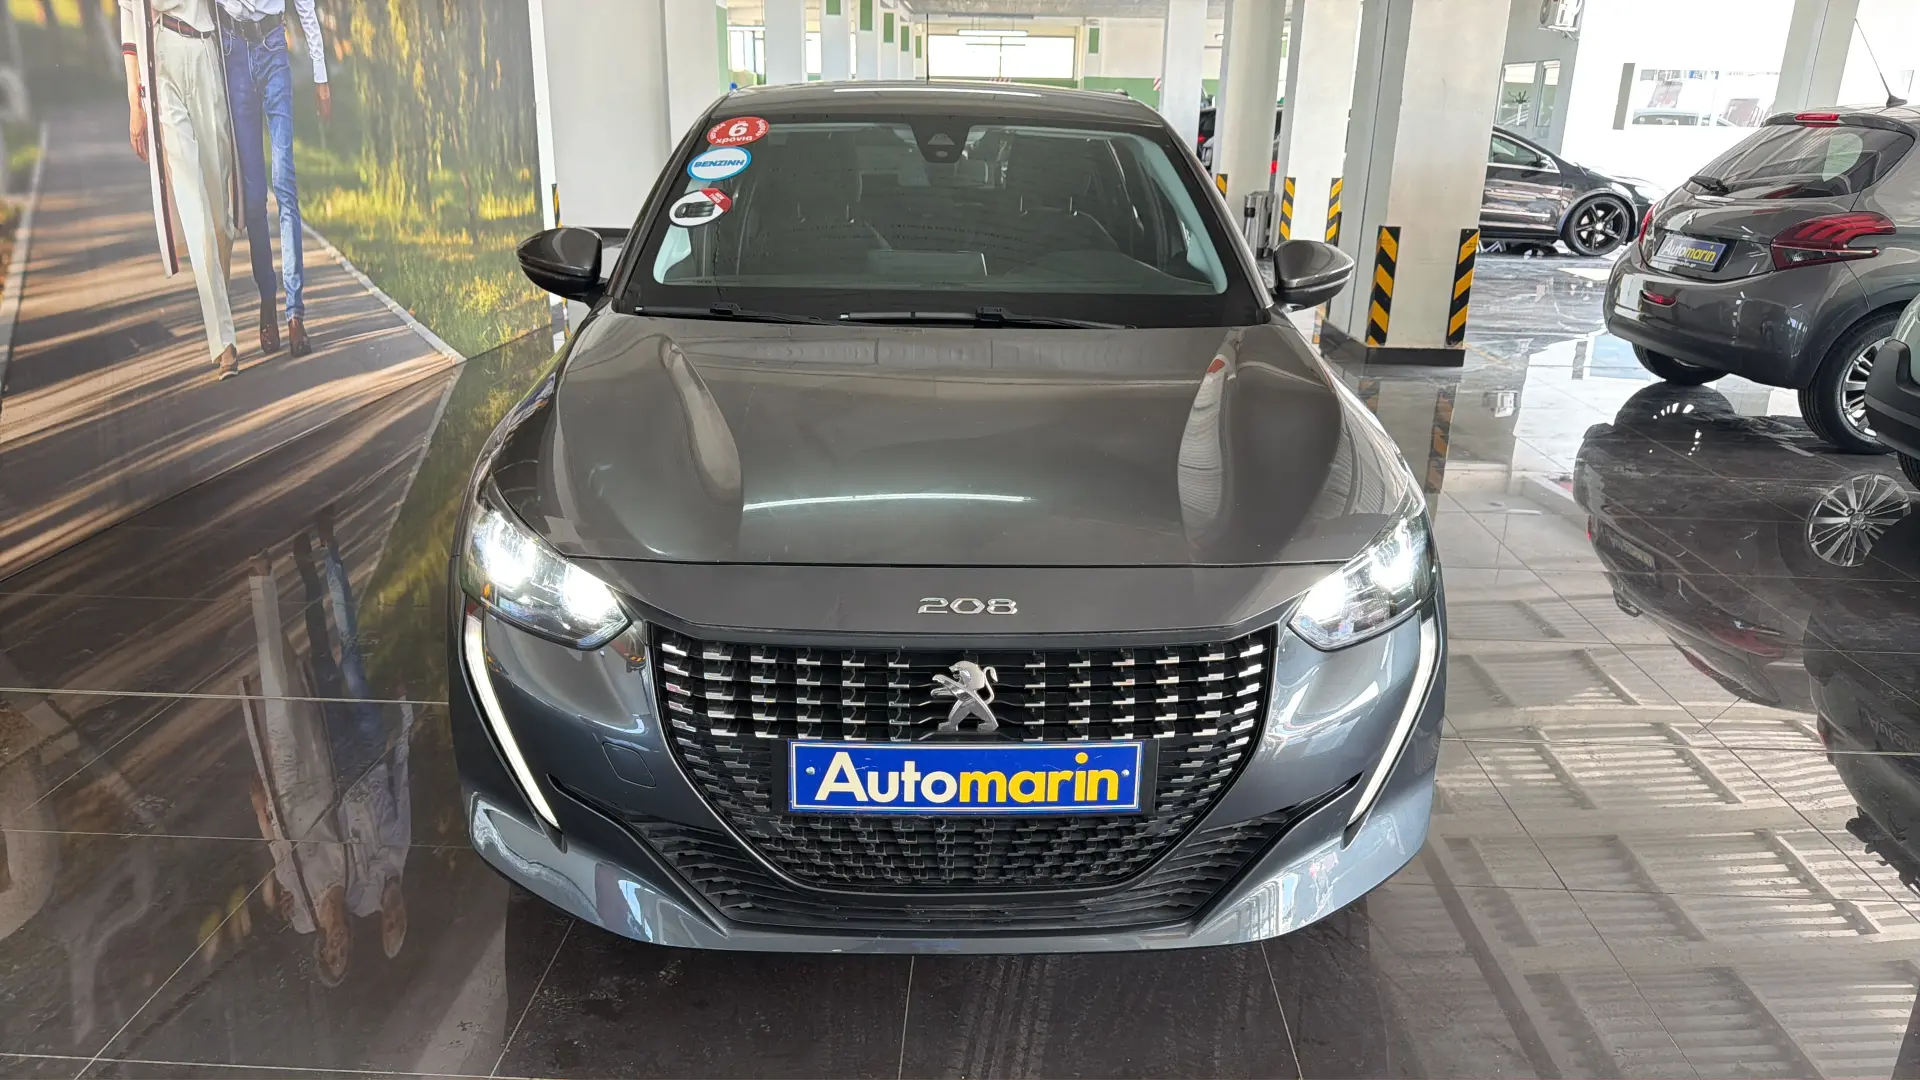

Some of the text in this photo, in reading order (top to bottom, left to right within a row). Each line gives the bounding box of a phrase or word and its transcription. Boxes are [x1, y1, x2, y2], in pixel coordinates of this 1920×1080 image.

[728, 122, 748, 137] 6
[715, 135, 753, 144] χρόνια
[1661, 240, 1717, 262] Automarin
[917, 597, 1018, 615] 208
[814, 751, 1119, 803] Automarin
